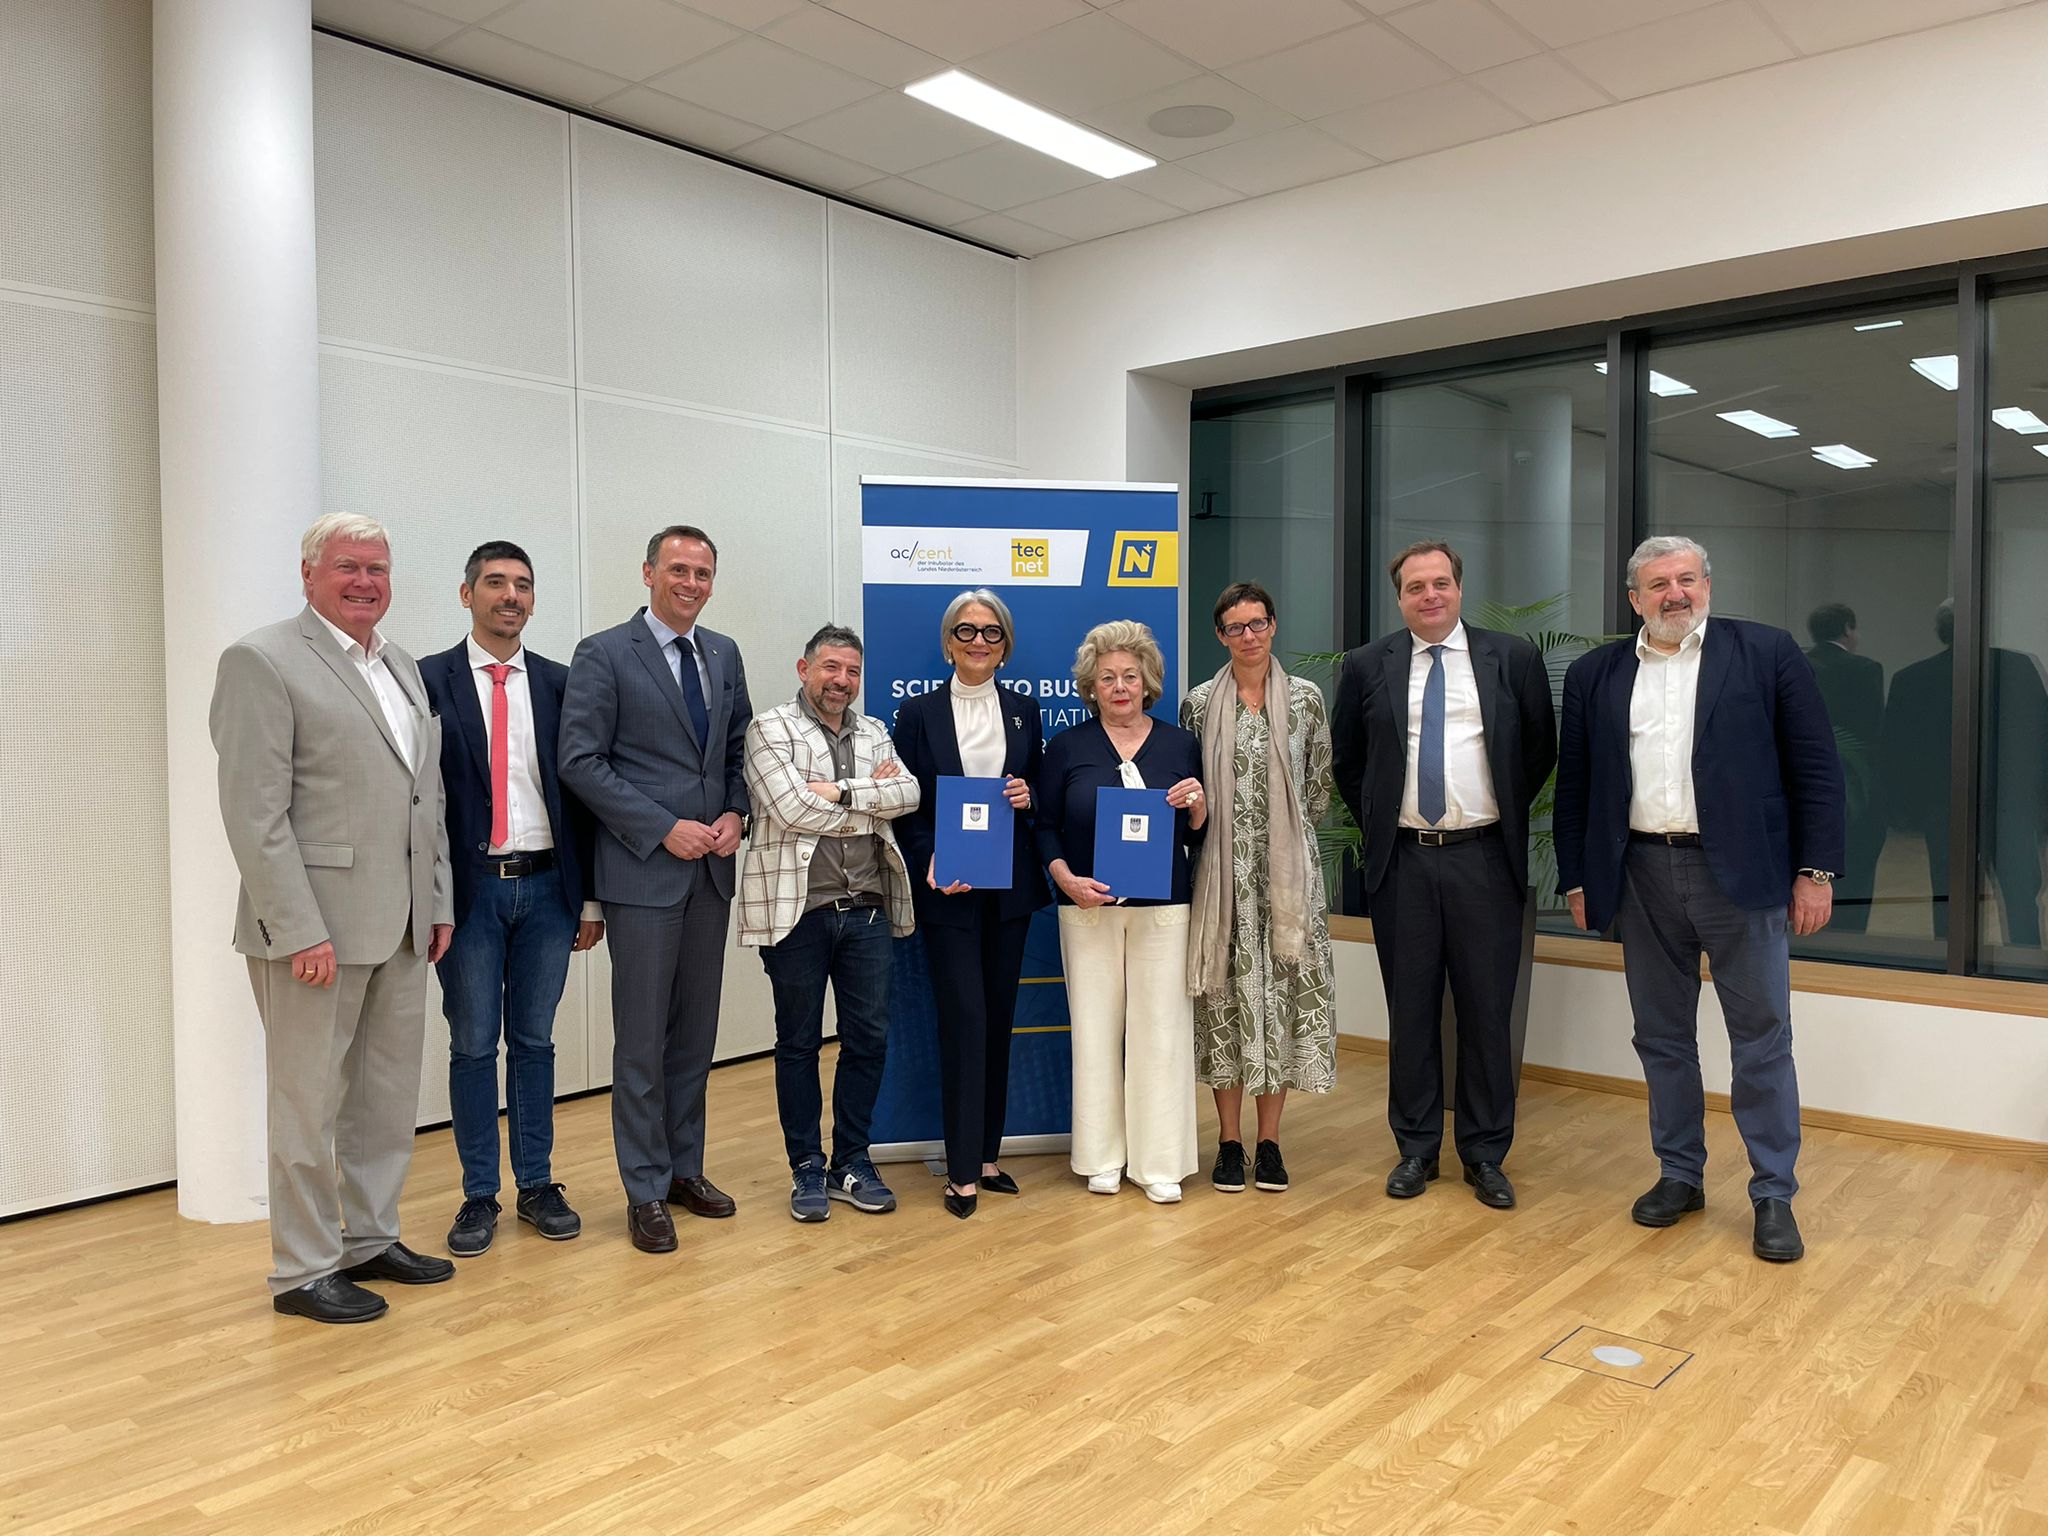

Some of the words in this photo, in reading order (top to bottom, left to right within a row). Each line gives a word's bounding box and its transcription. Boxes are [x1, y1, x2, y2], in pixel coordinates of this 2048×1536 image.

[1011, 540, 1044, 558] tec
[1015, 557, 1044, 573] net
[1000, 679, 1032, 697] TO
